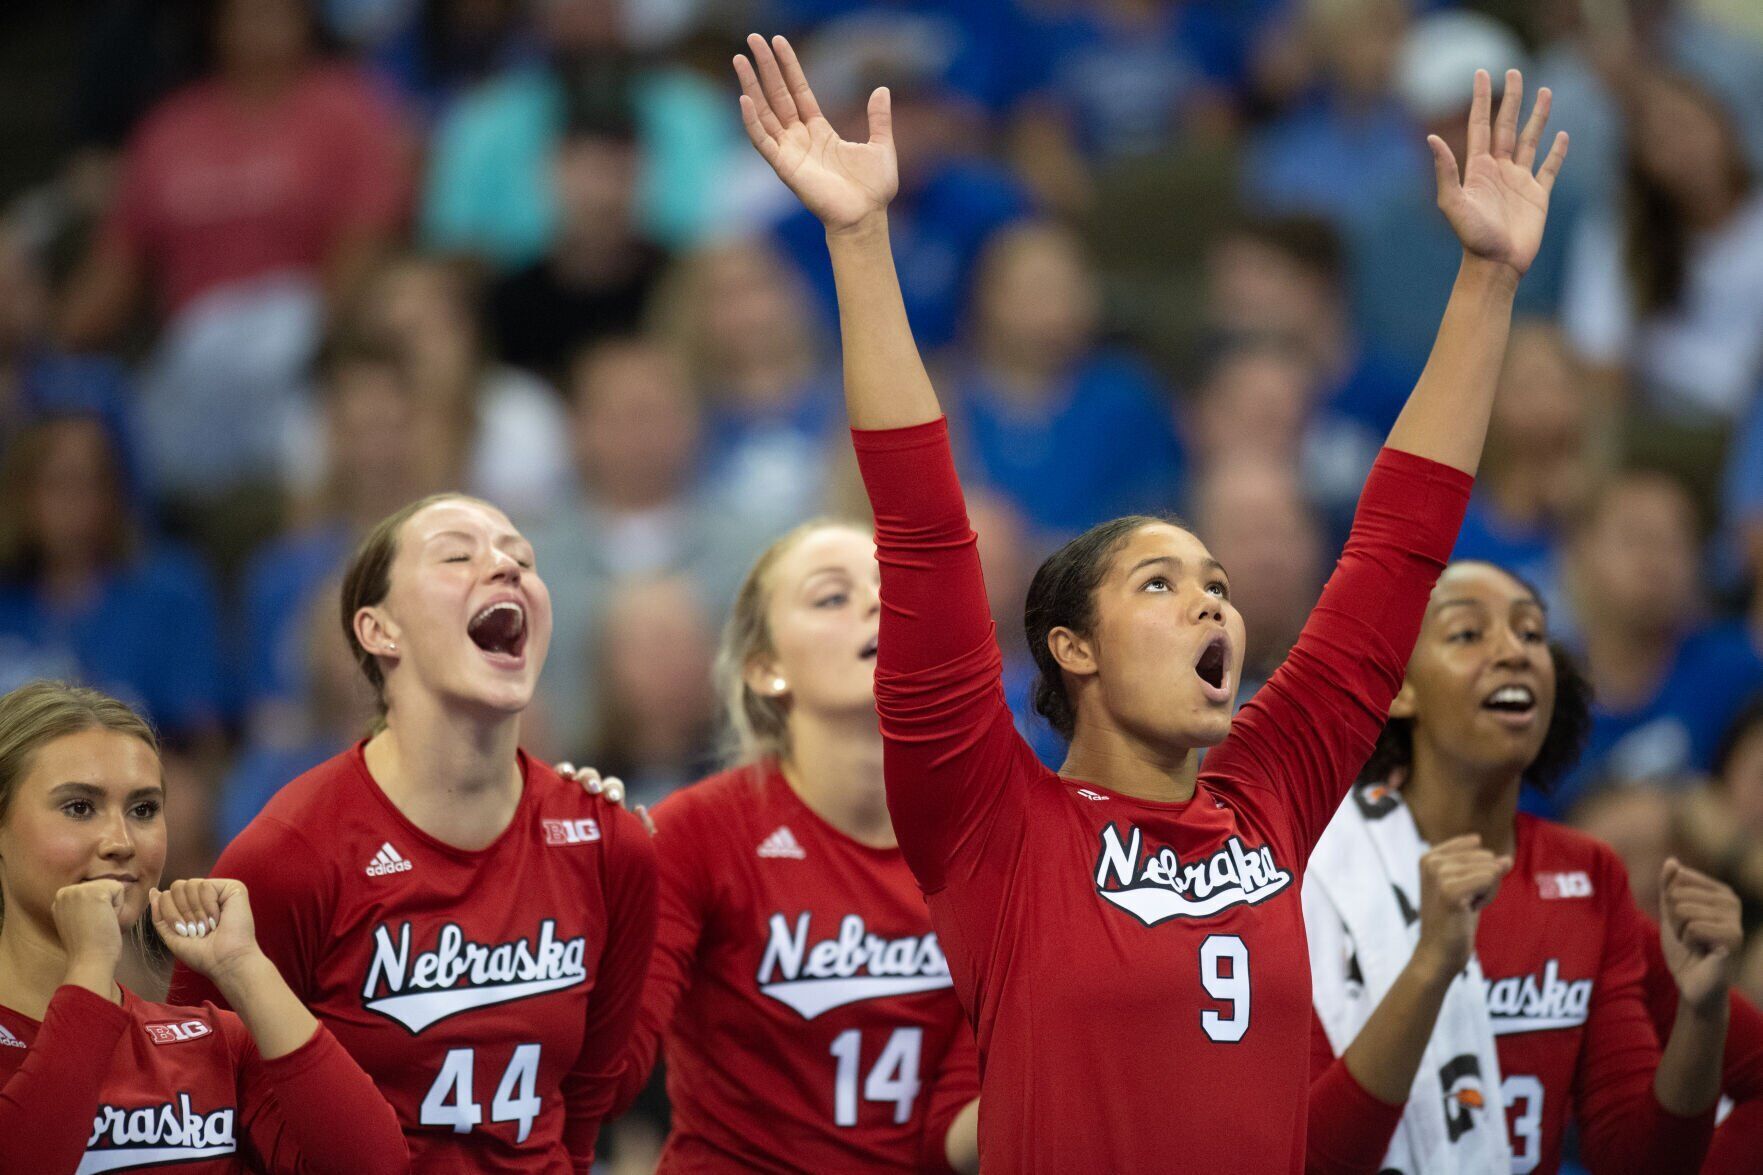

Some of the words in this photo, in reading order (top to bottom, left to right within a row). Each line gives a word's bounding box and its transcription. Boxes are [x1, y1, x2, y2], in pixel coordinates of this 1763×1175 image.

[366, 858, 412, 877] adidas
[1096, 824, 1288, 898] Nebraka
[363, 918, 586, 1000] Nebraska
[1199, 933, 1252, 1044] 9
[420, 1043, 541, 1144] 44
[829, 1027, 923, 1127] 14
[1501, 1075, 1544, 1175] 3
